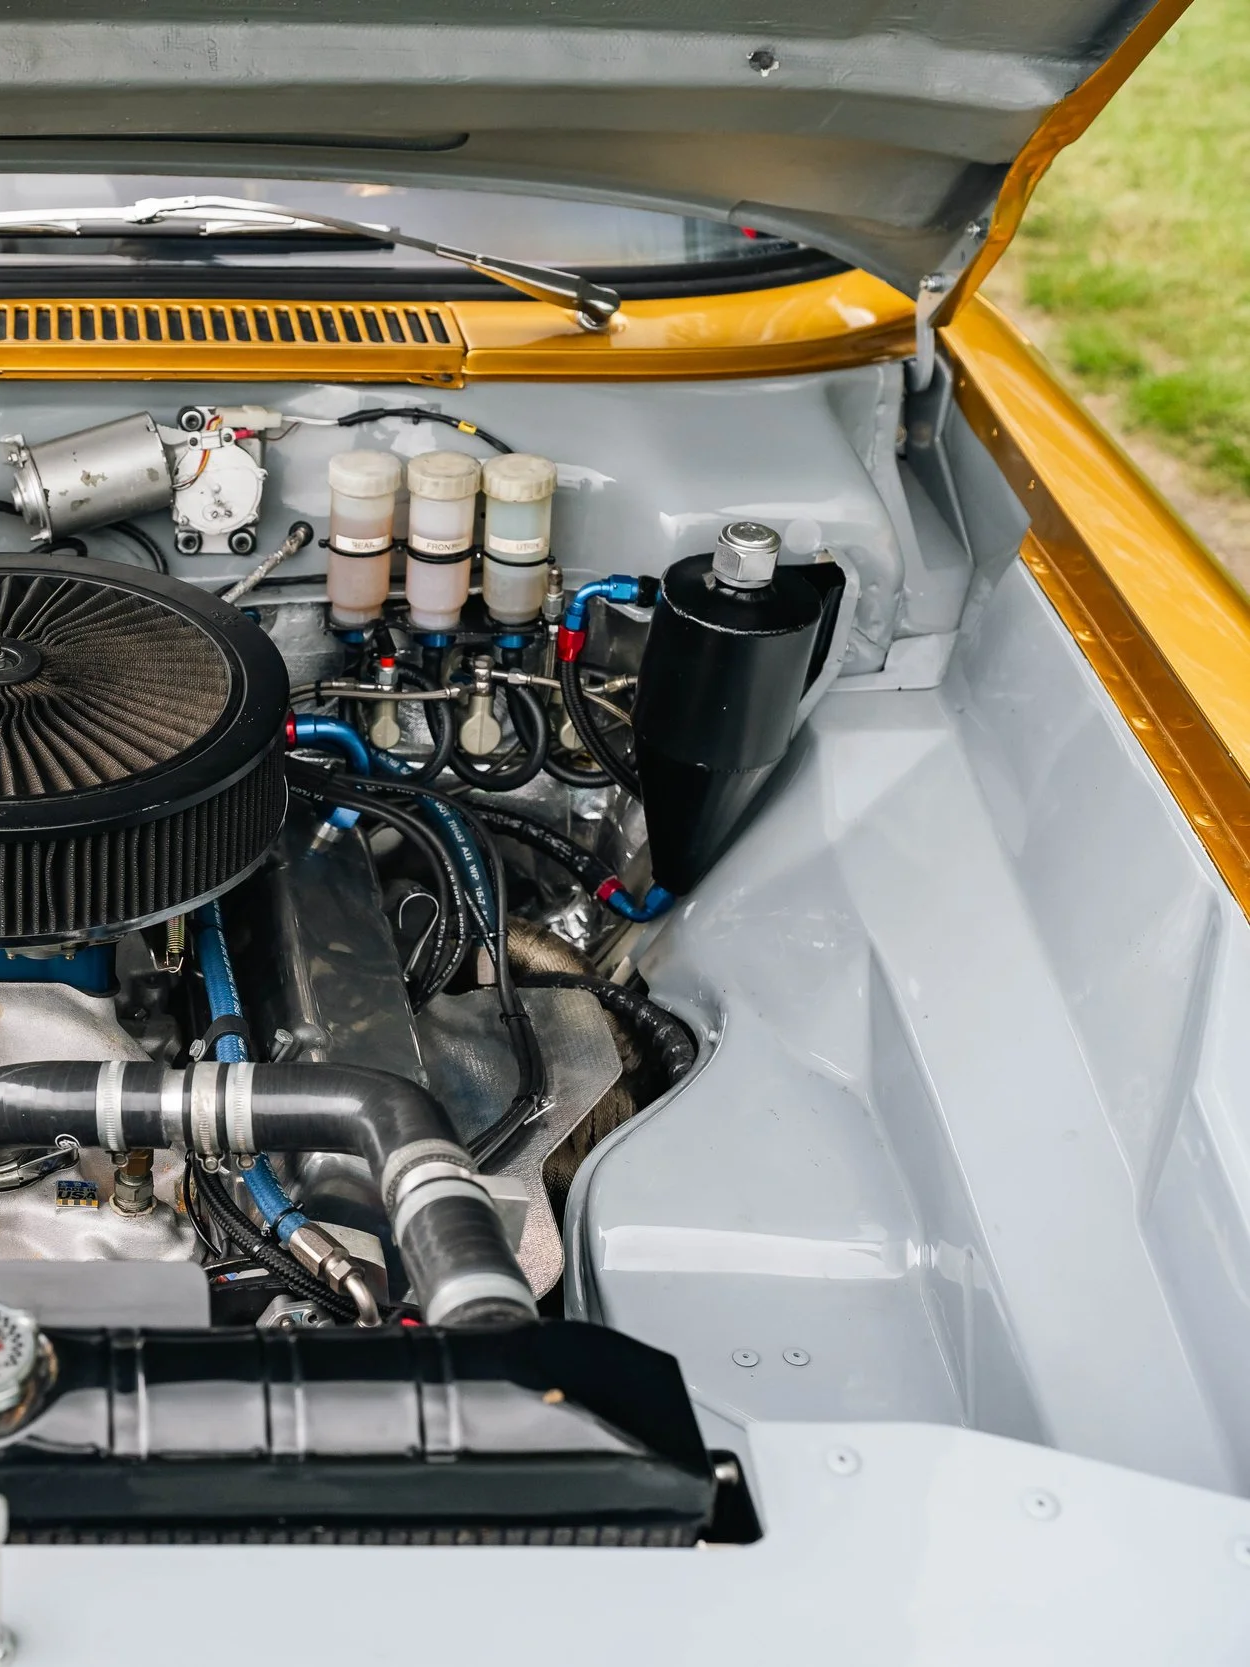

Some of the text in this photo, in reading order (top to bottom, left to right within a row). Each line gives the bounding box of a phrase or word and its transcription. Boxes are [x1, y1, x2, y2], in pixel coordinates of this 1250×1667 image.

[468, 864, 480, 881] WP
[452, 885, 462, 906] MADE
[58, 1191, 96, 1200] USA
